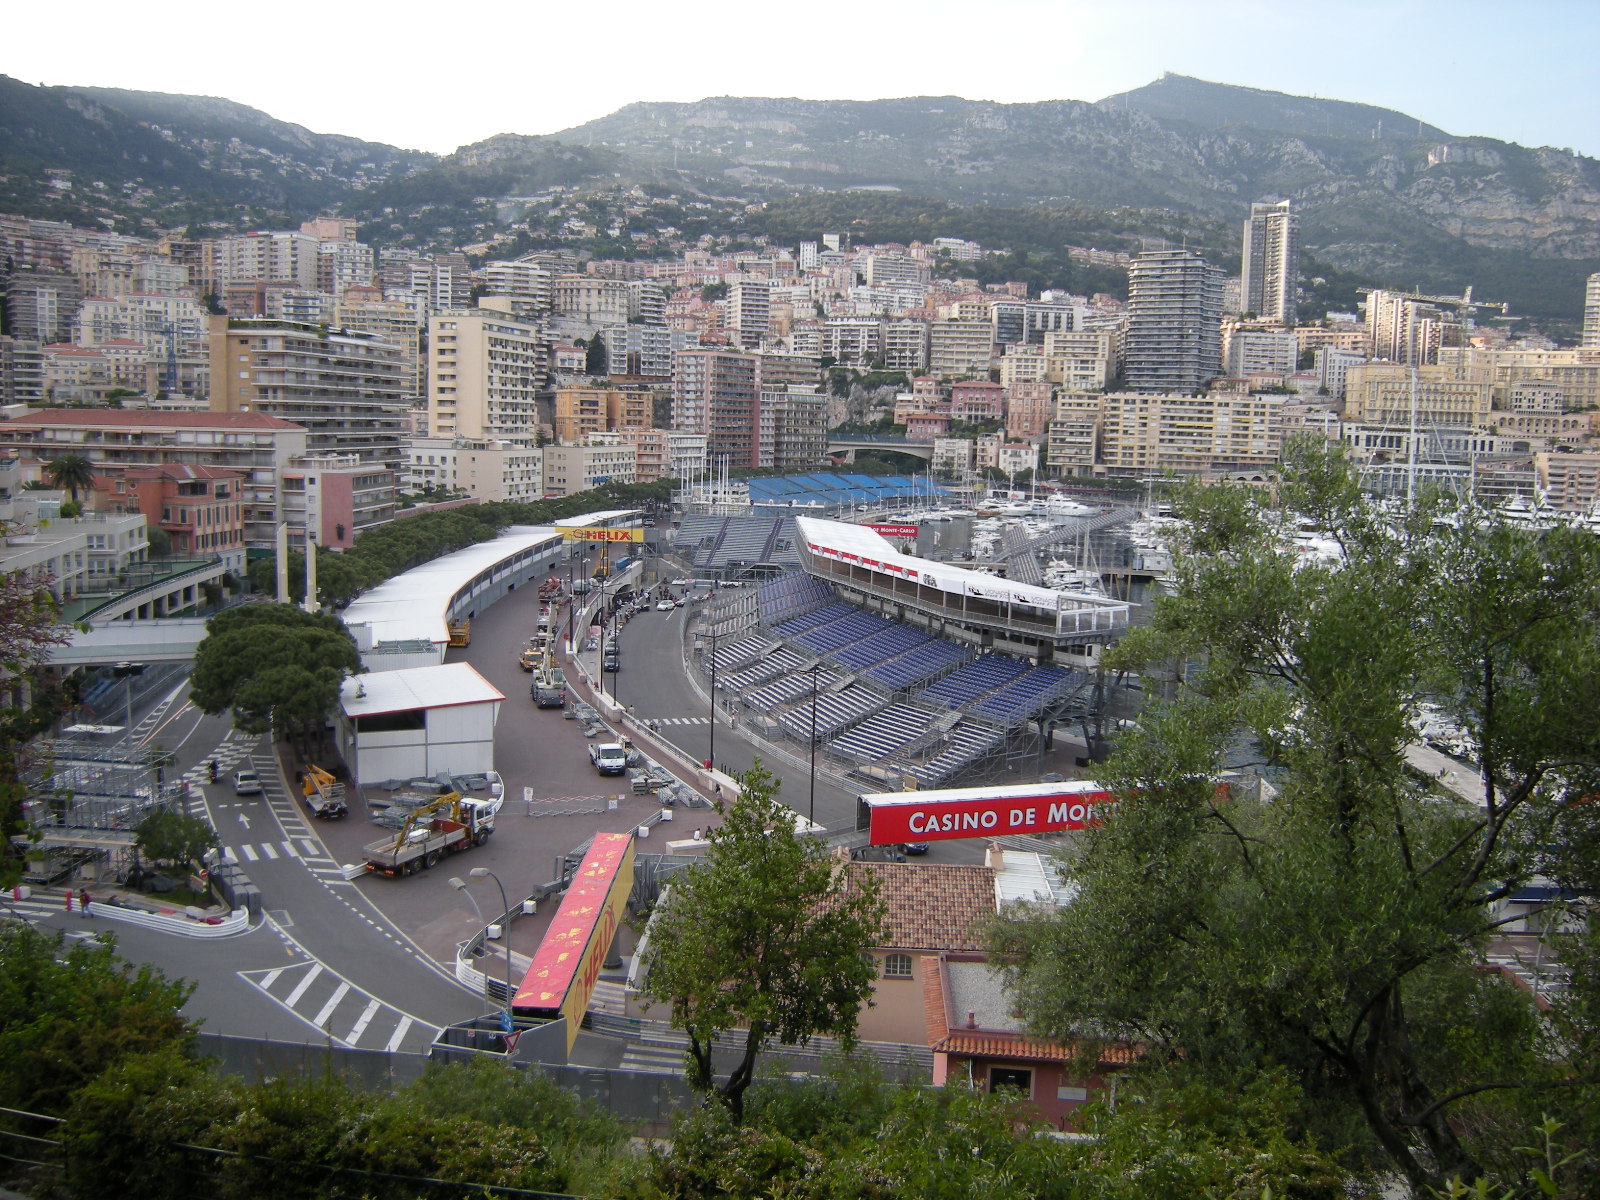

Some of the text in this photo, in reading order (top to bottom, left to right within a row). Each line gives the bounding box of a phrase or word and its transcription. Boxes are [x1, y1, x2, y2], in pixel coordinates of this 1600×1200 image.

[586, 530, 633, 541] HELIX
[908, 811, 998, 833] CASINO
[1009, 808, 1036, 826] DE
[584, 899, 615, 1007] HELIX
